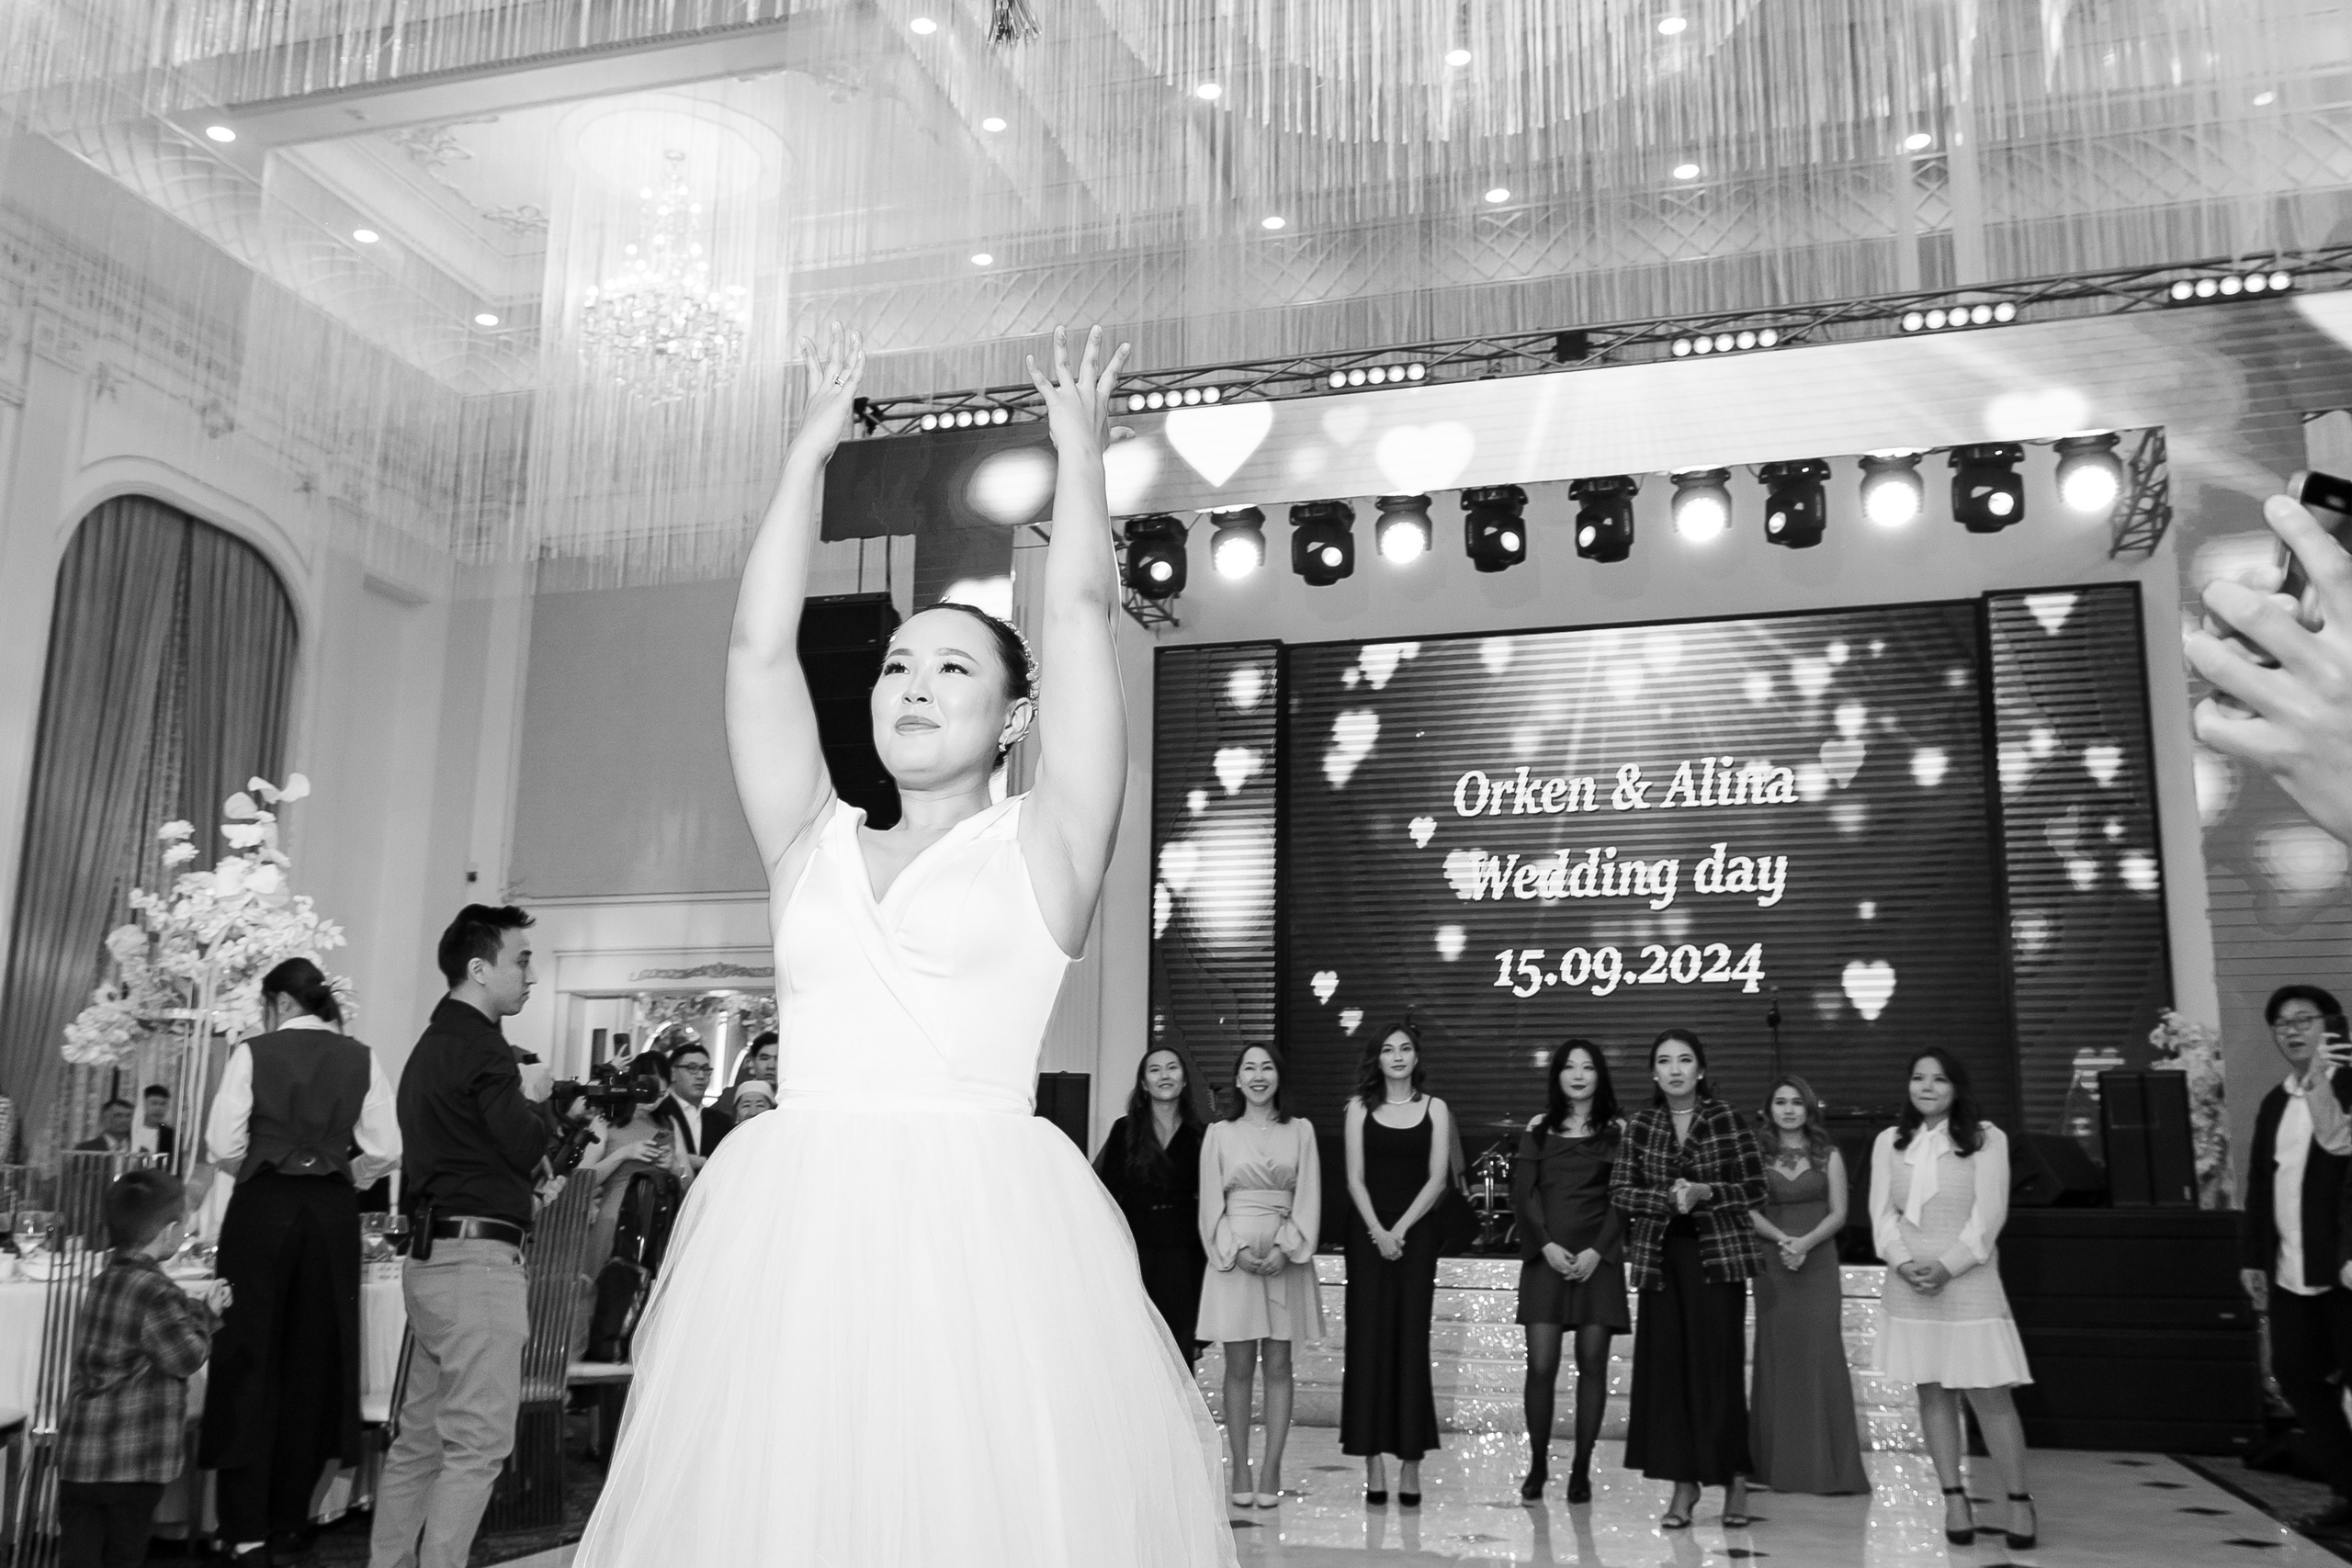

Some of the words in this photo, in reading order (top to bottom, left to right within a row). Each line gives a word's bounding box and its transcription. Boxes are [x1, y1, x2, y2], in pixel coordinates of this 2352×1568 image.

[1453, 766, 1600, 817] Orken
[1611, 762, 1653, 811] &
[1659, 756, 1799, 808] Alina
[1470, 846, 1680, 910] Wedding
[1693, 842, 1788, 908] day
[1494, 942, 1766, 998] 15.09.2024
